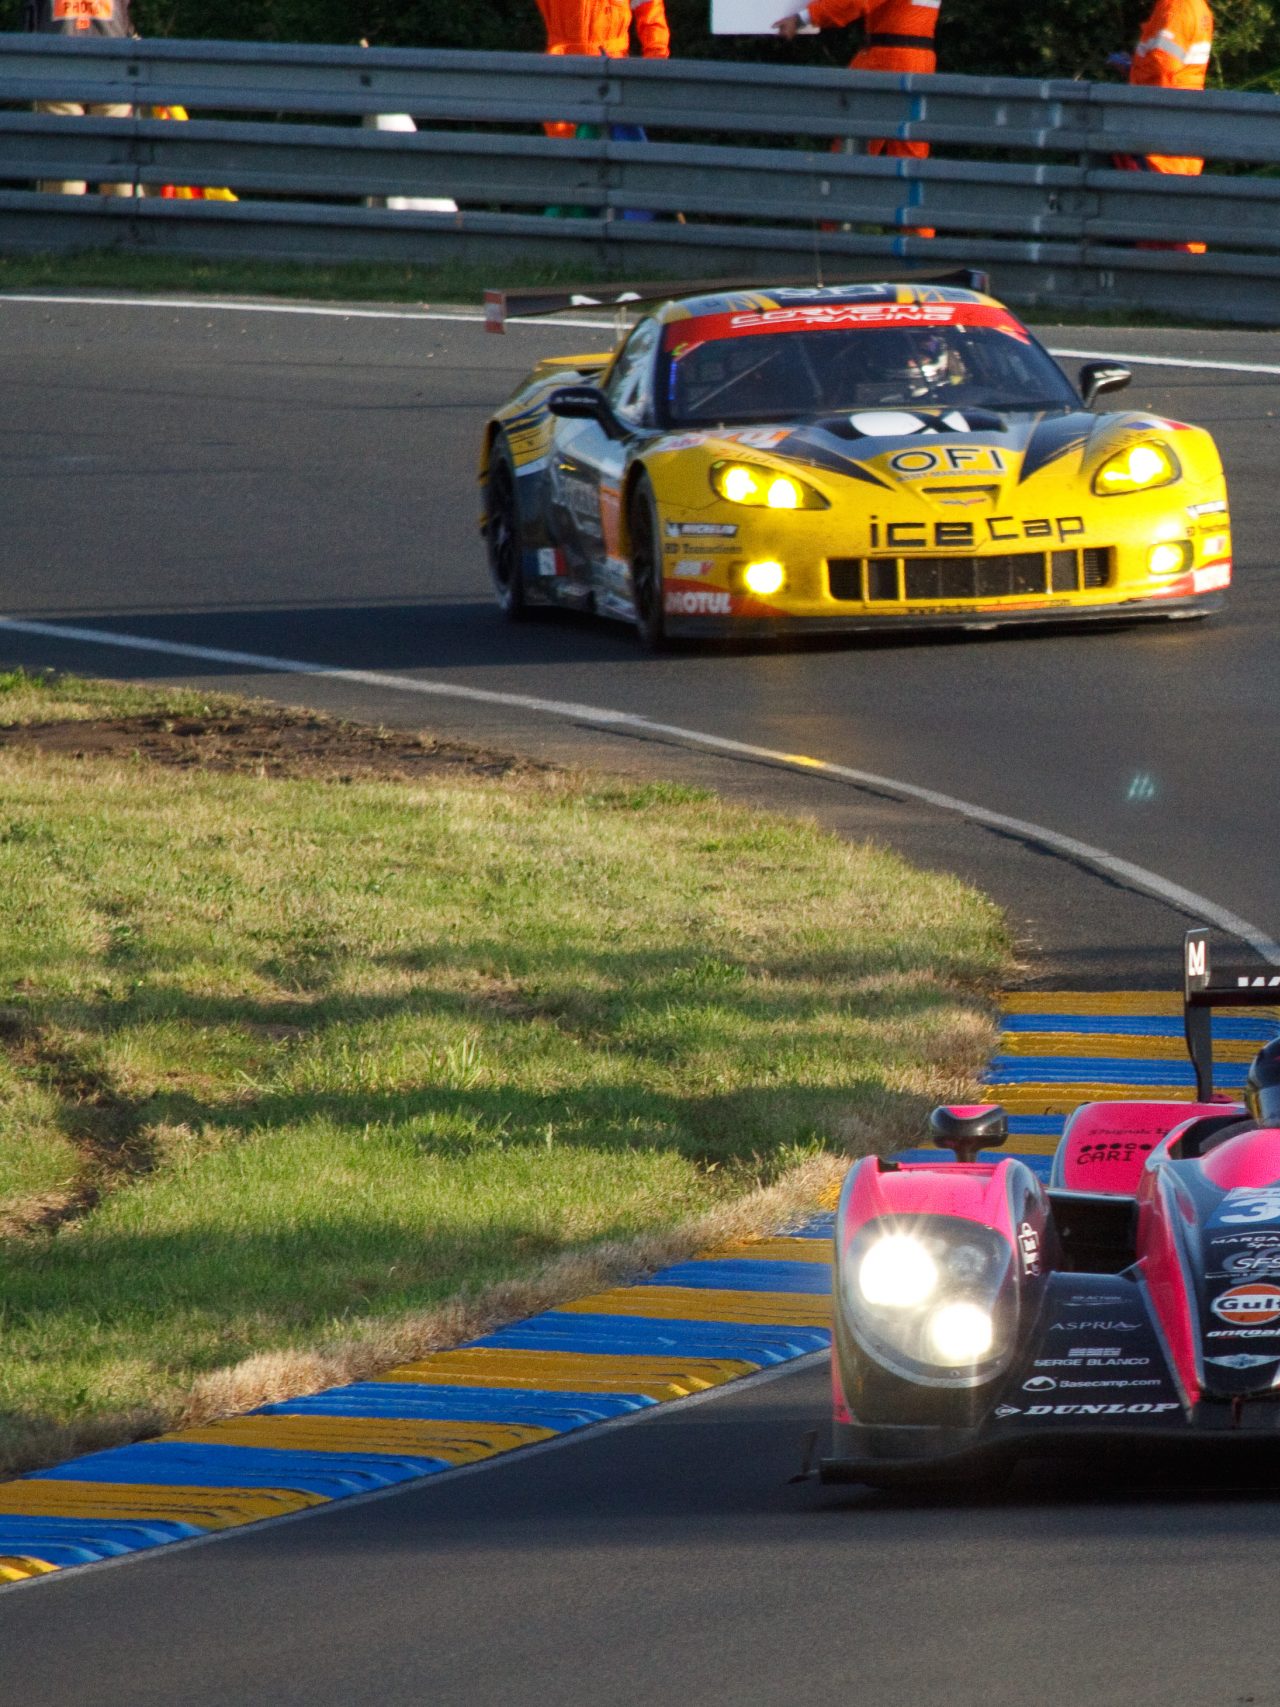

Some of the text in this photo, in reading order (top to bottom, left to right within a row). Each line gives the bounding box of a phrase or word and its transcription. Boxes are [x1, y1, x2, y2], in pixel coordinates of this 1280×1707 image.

[731, 304, 955, 328] CORVETTE
[805, 313, 951, 324] RACING
[890, 447, 1004, 472] OFI
[664, 592, 732, 614] MOTUL
[1049, 1320, 1128, 1331] ASPRIA
[1033, 1357, 1150, 1367] SERGE BLANCO
[1022, 1402, 1180, 1415] DUNLOP
